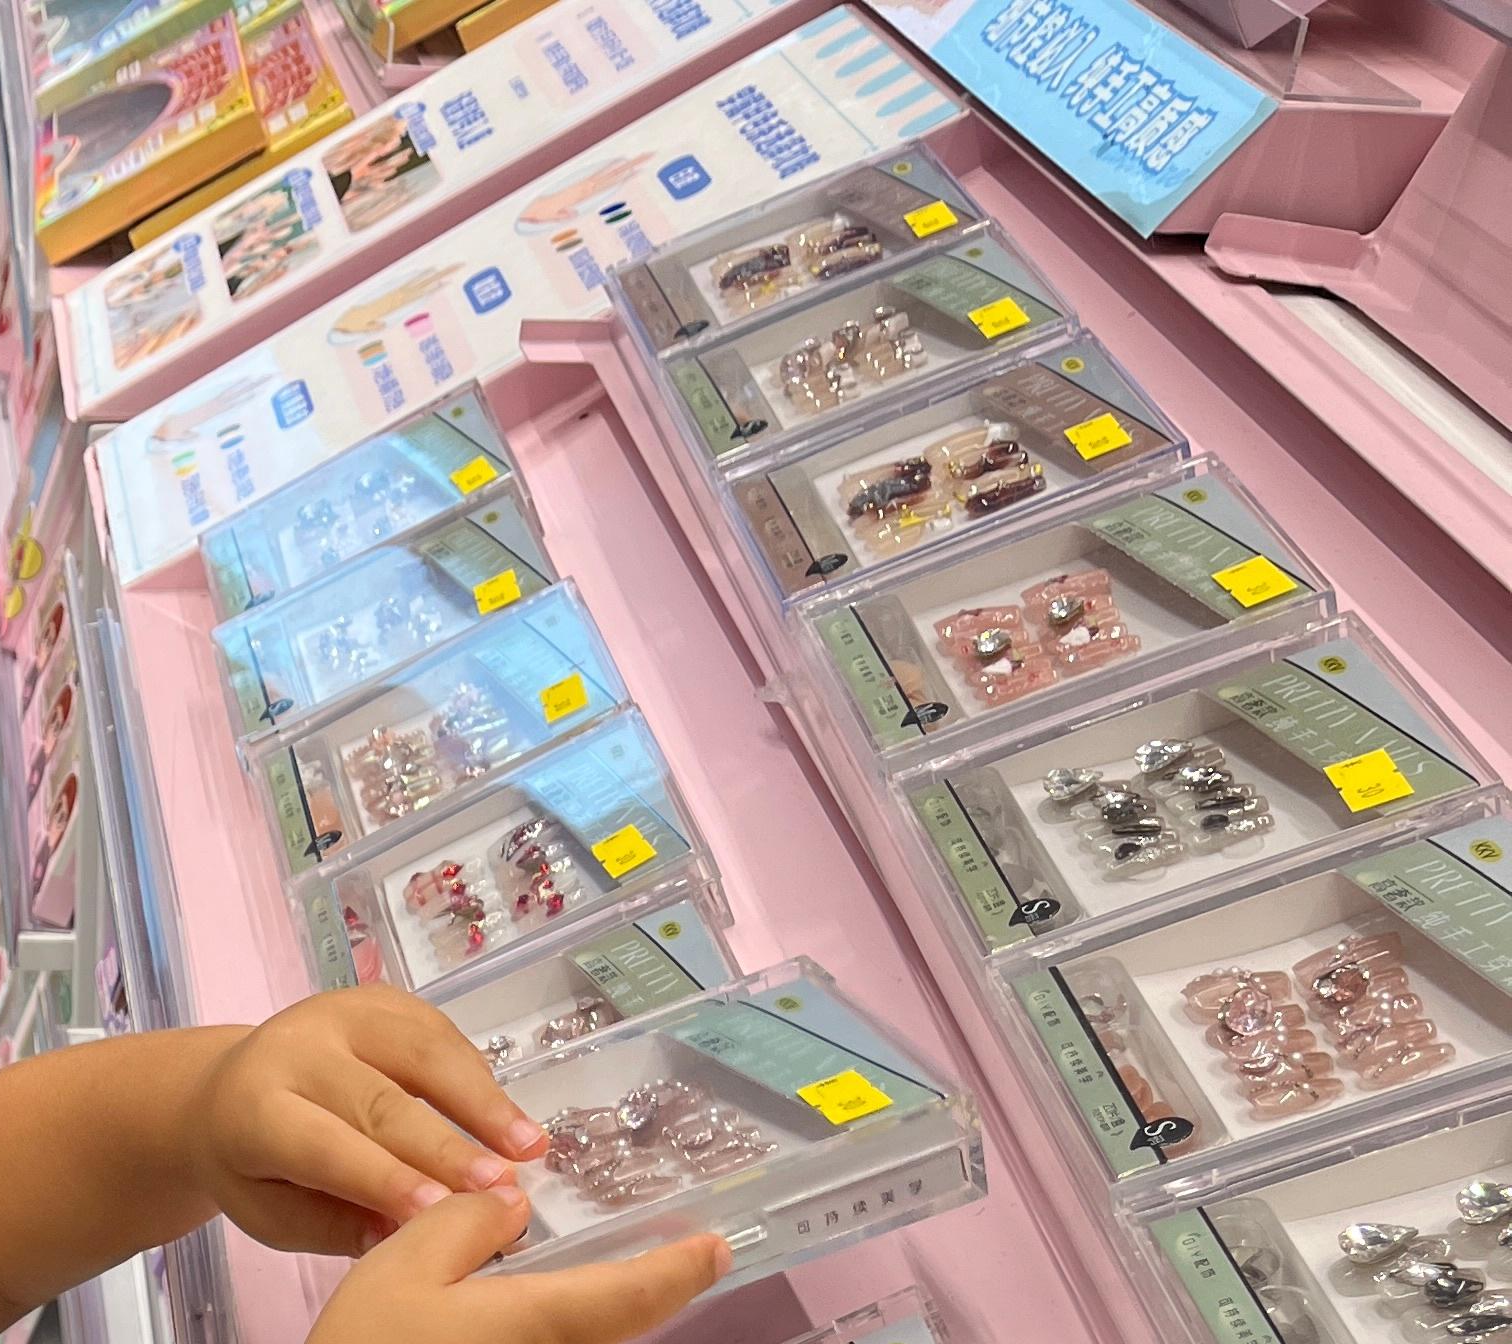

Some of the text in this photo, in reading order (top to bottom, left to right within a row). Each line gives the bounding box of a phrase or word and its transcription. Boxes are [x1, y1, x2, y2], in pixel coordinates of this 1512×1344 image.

[1060, 42, 1218, 175] 纯手工高质感
